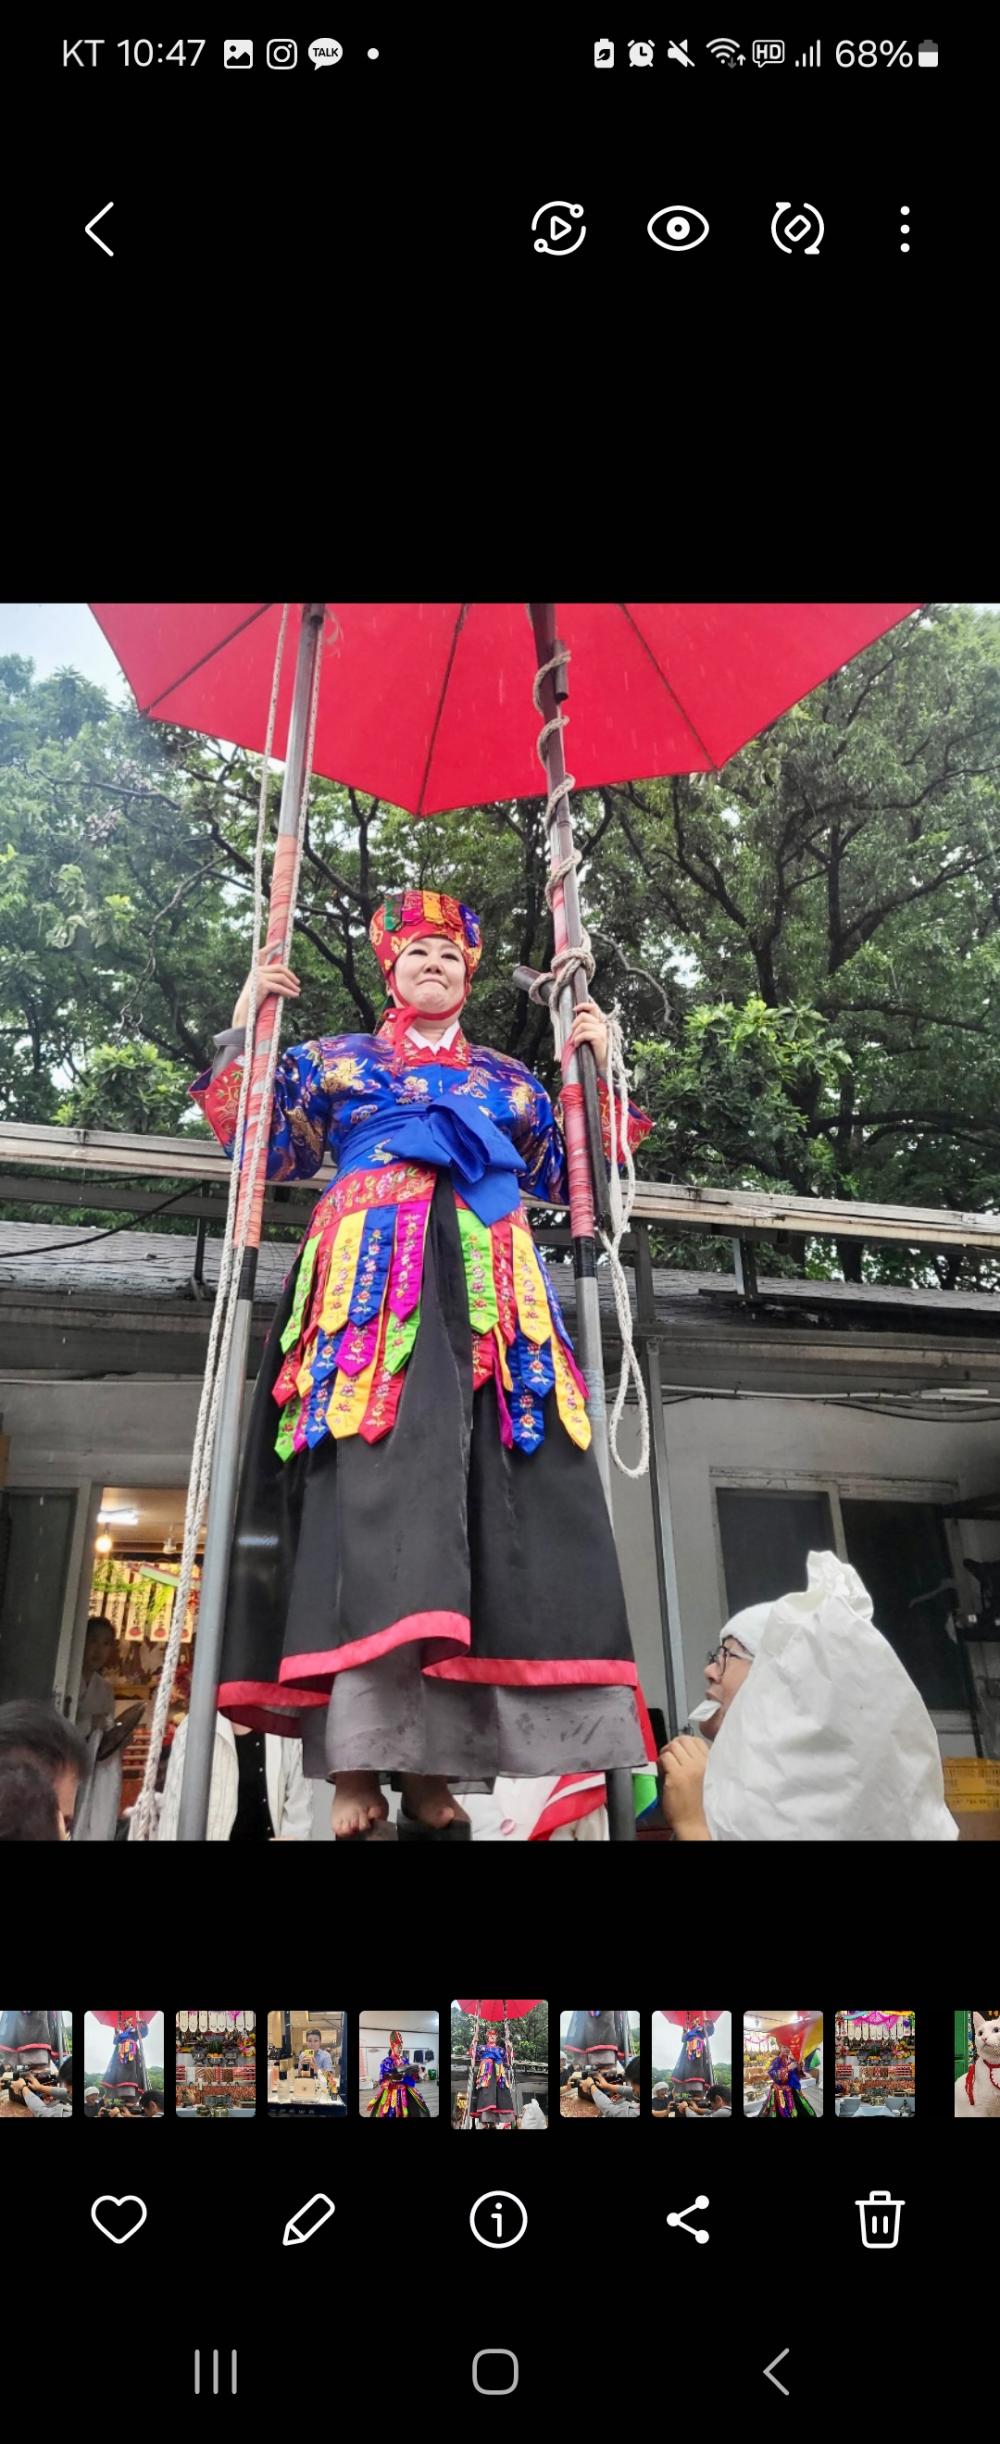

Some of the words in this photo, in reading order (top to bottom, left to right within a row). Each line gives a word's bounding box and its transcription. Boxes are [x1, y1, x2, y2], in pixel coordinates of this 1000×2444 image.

[63, 39, 106, 67] KT
[117, 39, 206, 67] 10:47
[312, 47, 339, 57] TALK
[756, 44, 782, 60] HD
[835, 39, 914, 68] 68%
